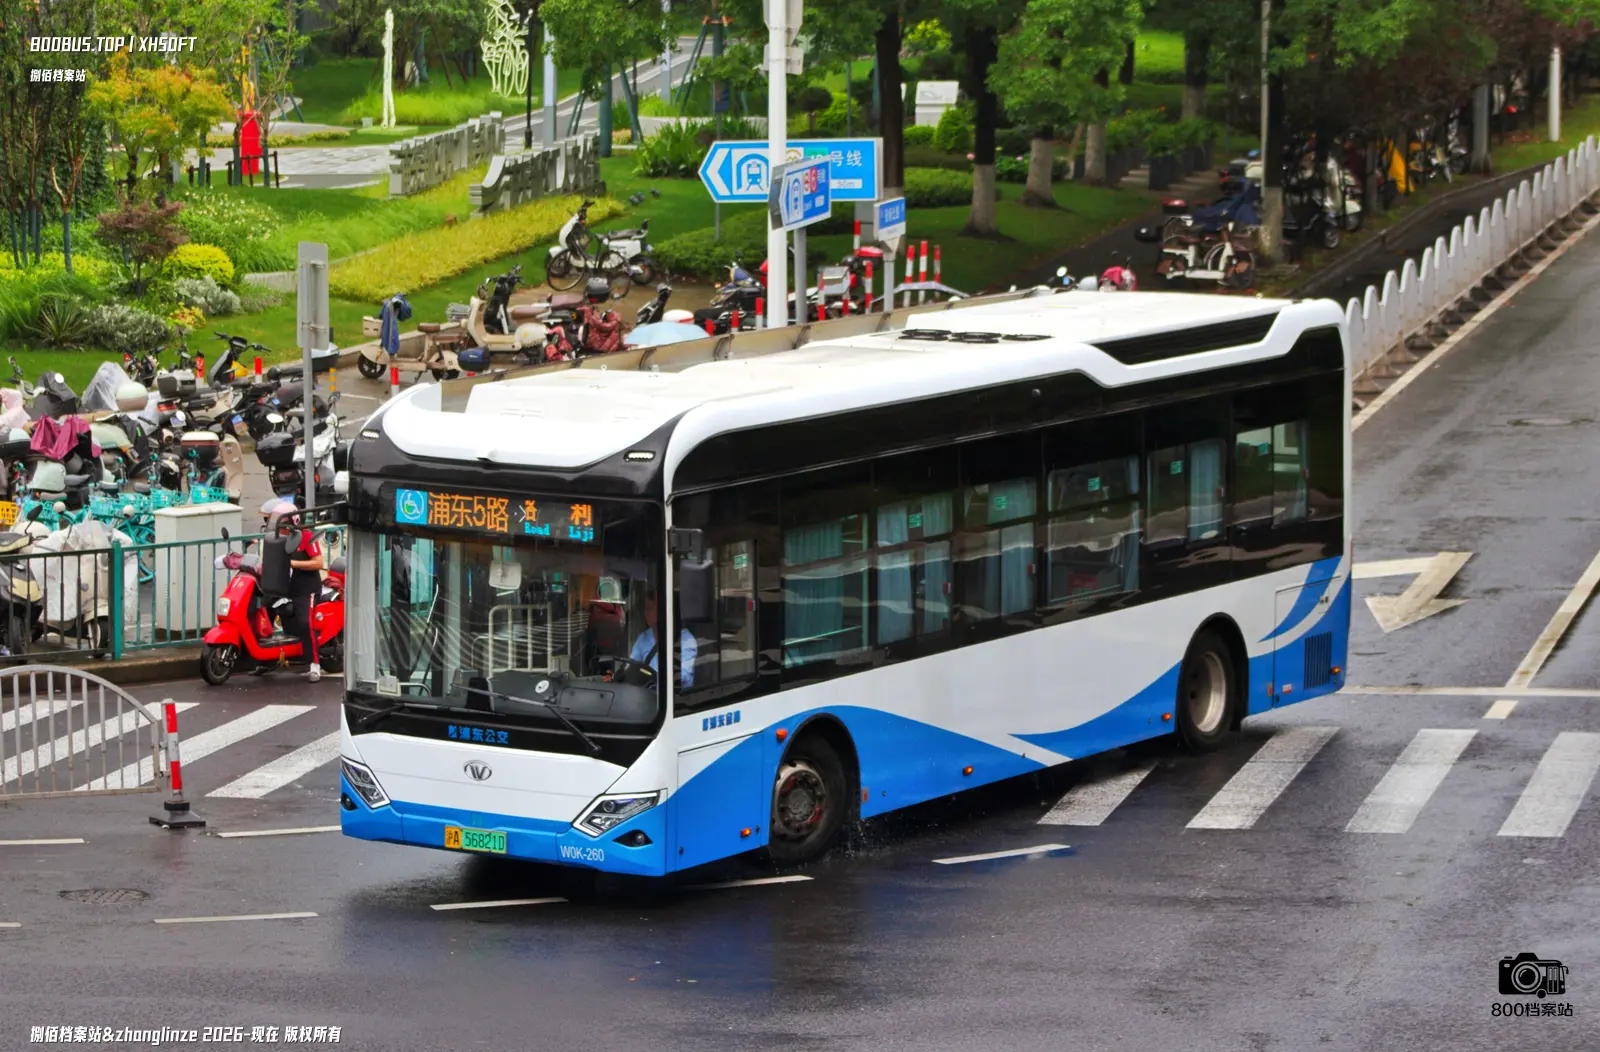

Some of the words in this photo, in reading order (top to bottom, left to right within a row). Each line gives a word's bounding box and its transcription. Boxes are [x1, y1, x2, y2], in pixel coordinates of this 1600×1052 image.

[427, 491, 509, 533] 浦东5路
[524, 522, 550, 536] Road
